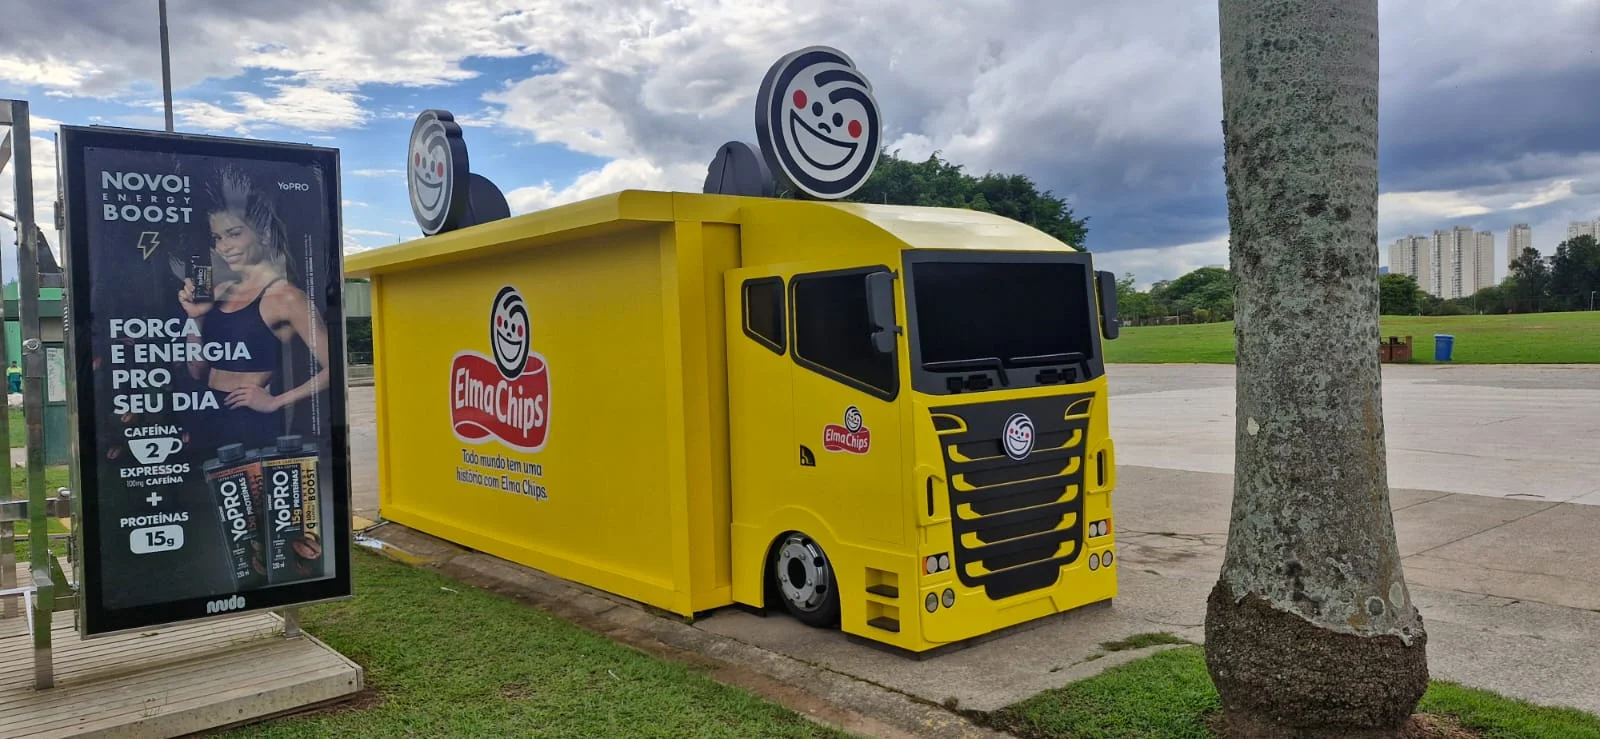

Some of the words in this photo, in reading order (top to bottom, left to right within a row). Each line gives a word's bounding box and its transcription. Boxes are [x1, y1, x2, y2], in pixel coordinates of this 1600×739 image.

[102, 171, 190, 194] NOVO!
[278, 182, 309, 192] YoPRO
[103, 193, 190, 204] ENERGY
[104, 204, 192, 223] BOOST
[110, 318, 201, 342] FORÇA
[111, 344, 125, 364] E
[134, 342, 252, 362] ENERGIA
[112, 368, 171, 389] PRO
[114, 393, 163, 414] SEU
[172, 391, 220, 411] DIA
[146, 443, 160, 458] 2
[120, 463, 190, 478] EXPRESSOS
[462, 449, 478, 464] Todo
[480, 454, 505, 469] mundo
[506, 456, 521, 472] tem
[524, 462, 542, 476] uma
[146, 476, 183, 486] CAFEÍNA
[306, 468, 316, 501] BOOST
[456, 466, 482, 484] história
[484, 476, 499, 488] com
[502, 476, 520, 492] Elma
[522, 480, 548, 501] Chips.
[220, 481, 248, 541] YoPRO
[272, 470, 291, 532] YoPRO
[120, 512, 188, 528] PROTEÍNAS
[292, 509, 301, 524] 15g
[146, 531, 174, 546] 15g
